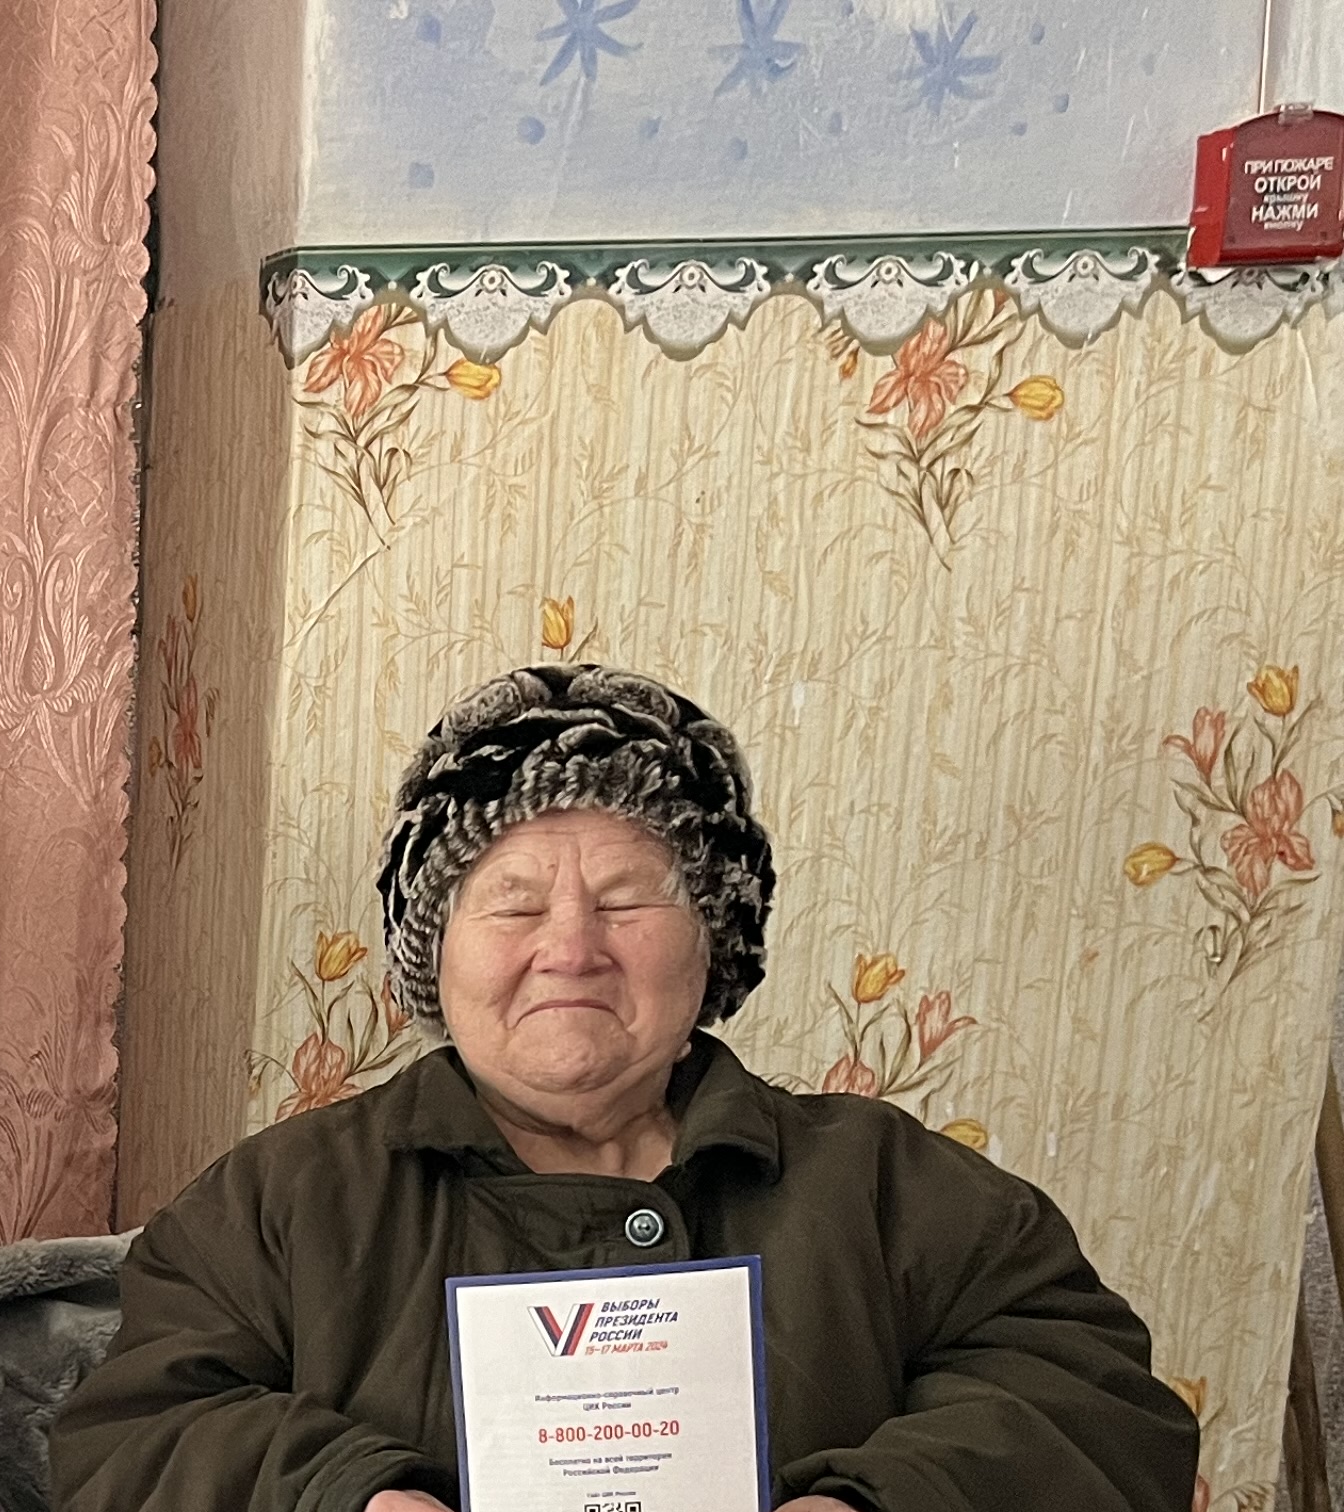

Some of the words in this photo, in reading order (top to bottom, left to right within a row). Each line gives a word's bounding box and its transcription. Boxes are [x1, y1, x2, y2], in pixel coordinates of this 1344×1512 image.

[1244, 160, 1272, 174] ПРИ
[1274, 156, 1334, 172] ПОЖАРЕ
[1254, 171, 1322, 193] ОТКРОЙ
[1251, 203, 1319, 223] НАЖМИ
[601, 1298, 660, 1313] ВЫБОРЫ
[595, 1312, 679, 1328] ПРЕЗИДЕНТА
[590, 1329, 643, 1342] РОССИИ
[611, 1342, 644, 1354] МАРТА
[538, 1419, 680, 1444] 8-800-200-00-20
